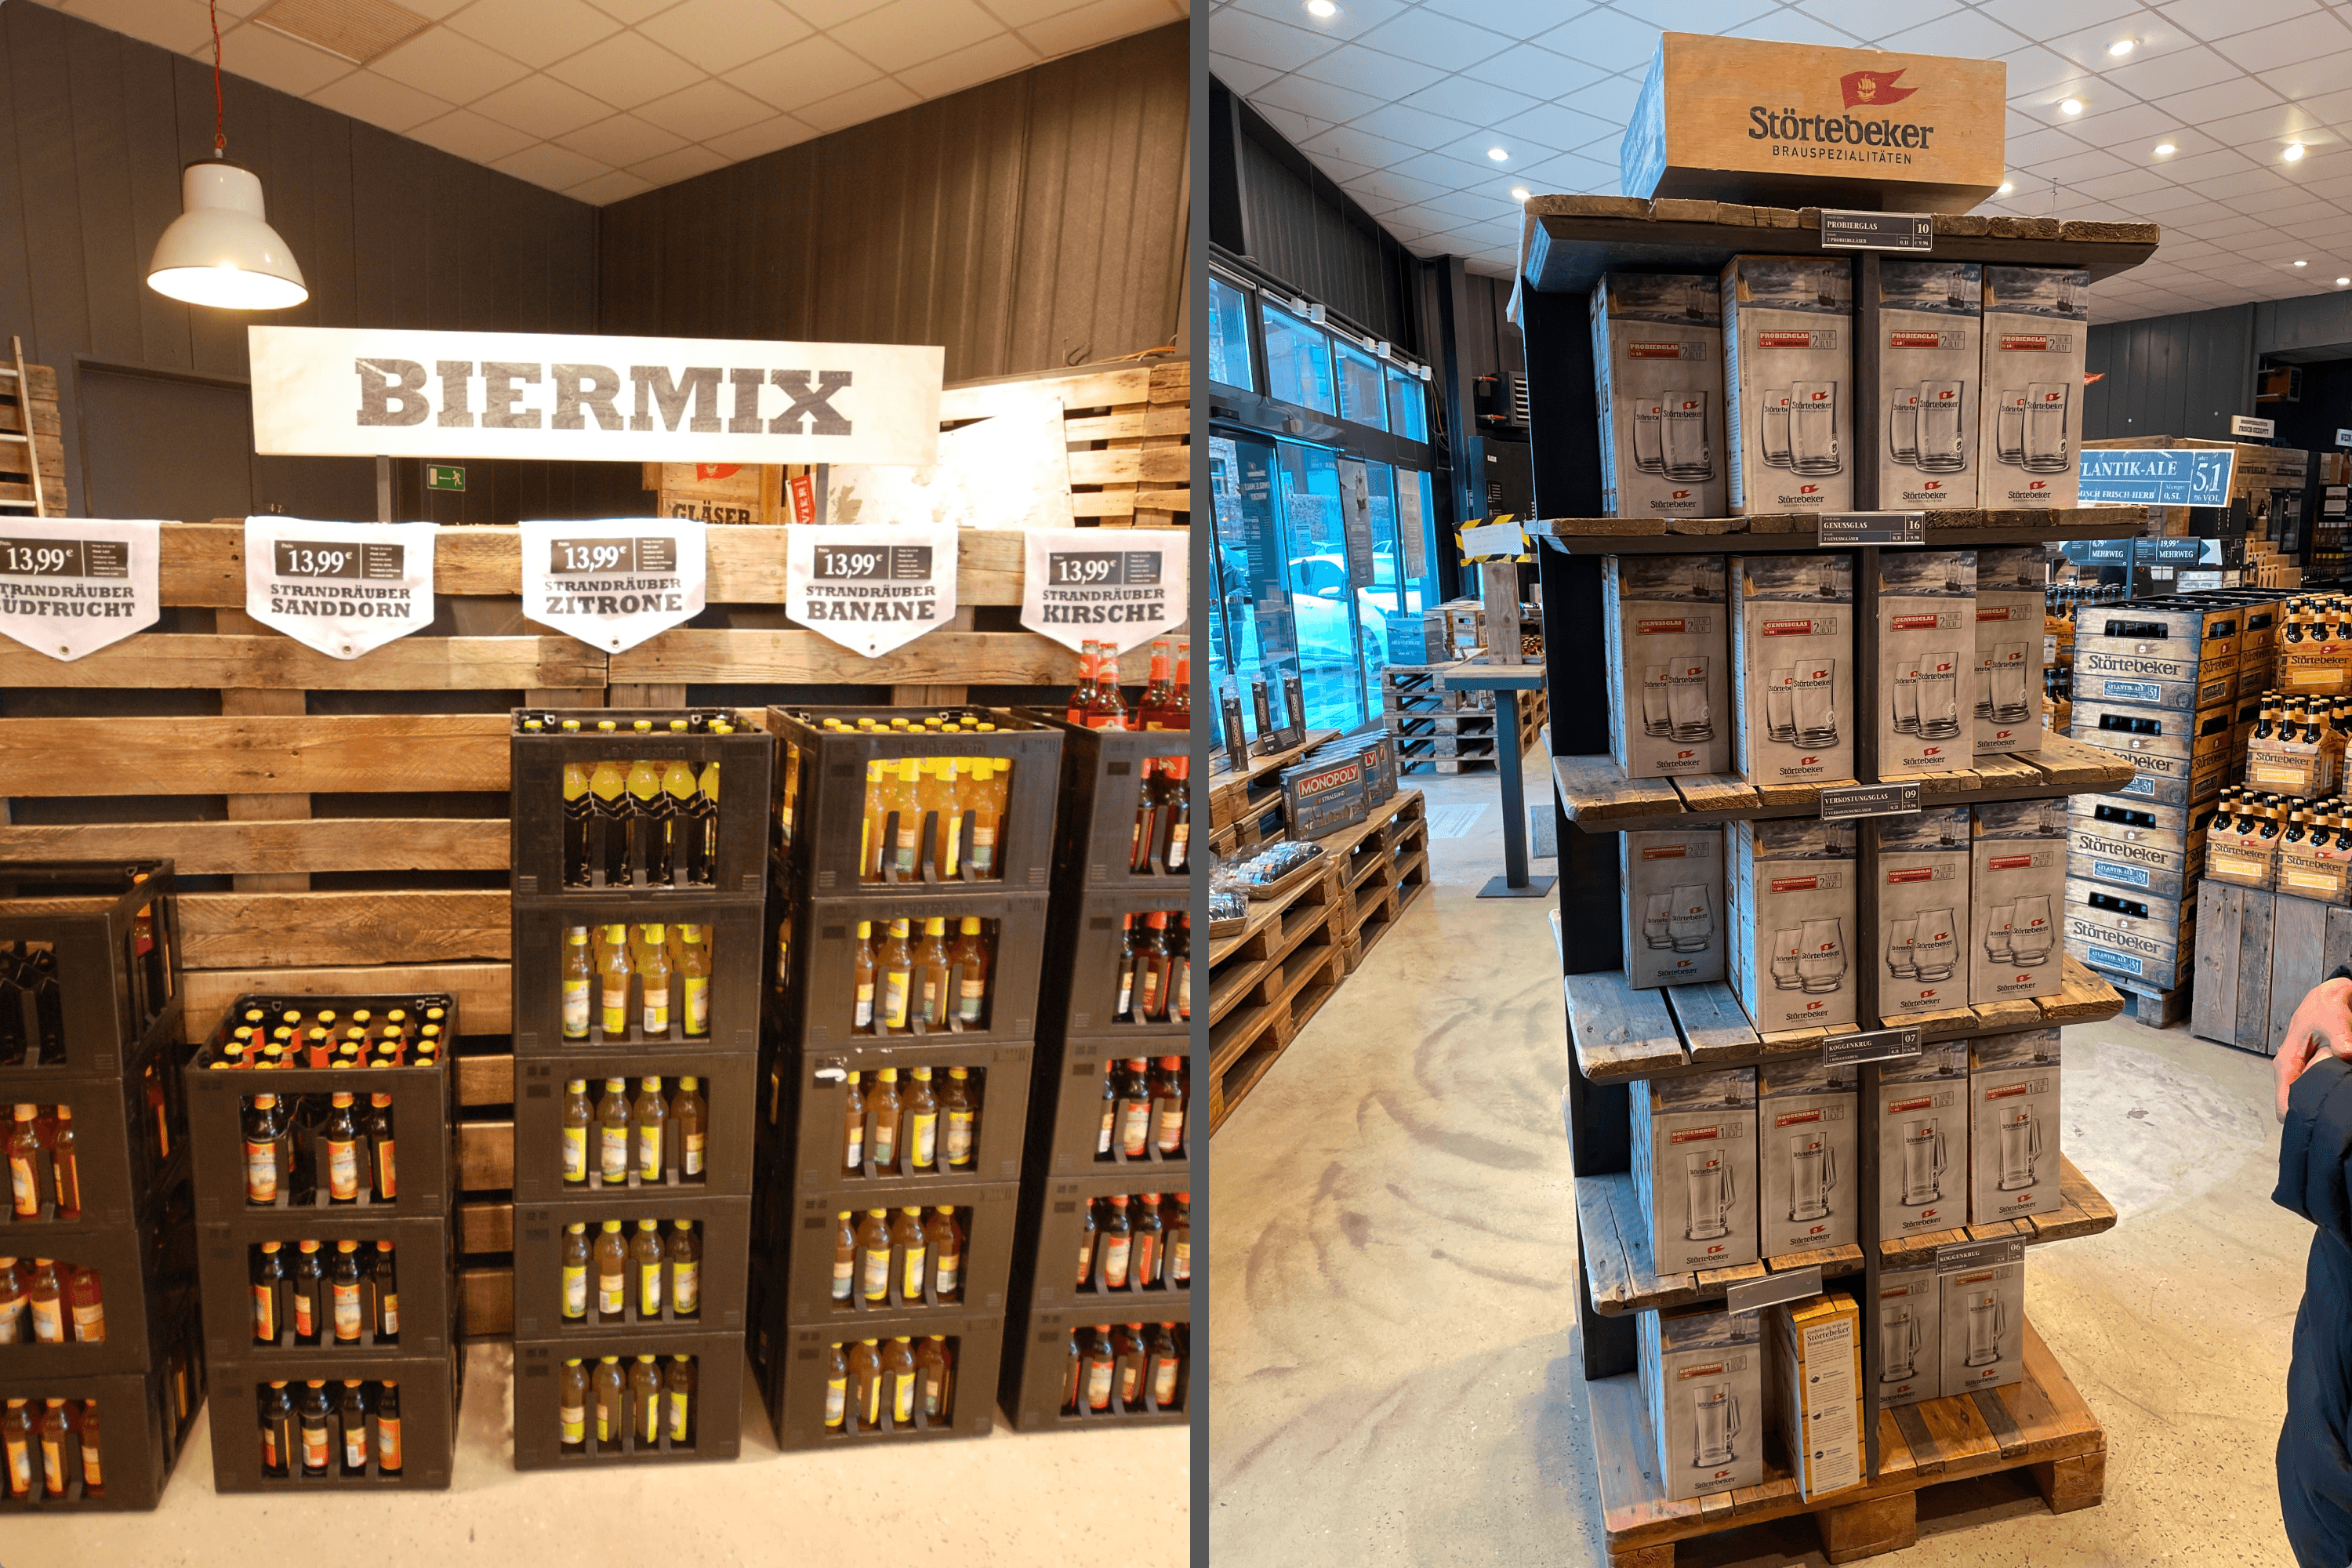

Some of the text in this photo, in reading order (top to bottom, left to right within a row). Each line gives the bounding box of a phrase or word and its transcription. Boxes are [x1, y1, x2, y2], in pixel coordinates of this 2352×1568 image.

[1749, 107, 1934, 149] Störtebeker
[1773, 145, 1911, 165] BRAUSPEZIALITÄTEN
[1827, 220, 1878, 230] PROBIERGLAS
[1917, 223, 1929, 234] 10
[1812, 334, 1819, 347] 2
[1941, 335, 1947, 347] 2
[2049, 338, 2055, 350] 2
[355, 357, 852, 436] BIERMIX
[1792, 401, 1831, 410] Störtebeker
[1919, 400, 1958, 409] Störtebeker
[2027, 401, 2063, 410] Störtebeker
[1663, 410, 1703, 419] Störtebeker
[2193, 463, 2221, 492] 5,1
[1778, 495, 1824, 504] Störtebeker
[1903, 492, 1947, 501] Störtebeker
[2008, 491, 2051, 499] Störtebeker
[1650, 499, 1697, 509] Störtebeker
[672, 500, 750, 524] GLÄSER
[1909, 521, 1920, 529] 16
[545, 577, 681, 592] STRANDRÄUBER
[270, 584, 411, 599] STRANDRÄUBER
[806, 584, 935, 597] STRANDRÄUBER
[1043, 587, 1165, 601] STRANDRÄUBER
[0, 593, 135, 618] ÜDFRUCHT
[271, 598, 411, 618] SANDDORN
[546, 593, 682, 615] ZITRONE
[806, 600, 935, 622] BANANE
[1043, 603, 1165, 623] KIRSCHE
[1940, 616, 1945, 627] 2
[1688, 622, 1693, 633] 2
[1813, 622, 1819, 634] 2
[2089, 655, 2181, 675] Störtebeker
[2292, 655, 2349, 665] Störtebeker
[2202, 658, 2235, 675] Störtebeker
[1668, 675, 1706, 684] Störtebeker
[1918, 672, 1955, 681] Störtebeker
[1793, 679, 1831, 688] Störtebeker
[1232, 717, 1241, 746] MONOPOLY
[1977, 739, 2016, 748] Störtebeker
[1657, 759, 1700, 768] Störtebeker
[1903, 757, 1945, 766] Störtebeker
[2196, 751, 2227, 770] Störtebeker
[2256, 753, 2310, 766] Störtebeker
[1780, 766, 1824, 775] Störtebeker
[1301, 766, 1357, 796] MONOPOLY
[1322, 790, 1345, 803] STRALSUND
[1824, 793, 1889, 804] VERKOSTUNGSGLAS
[1905, 789, 1916, 799] 09
[2079, 836, 2169, 864] Störtebeker
[2214, 844, 2267, 860] Störtebeker
[2287, 855, 2343, 872] Störtebeker
[1820, 877, 1825, 888] 2
[1671, 913, 1708, 922] Störtebeker
[2013, 925, 2049, 935] Störtebeker
[2074, 921, 2160, 954] Störtebeker
[1916, 939, 1952, 949] Störtebeker
[1802, 949, 1839, 960] Störtebeker
[1657, 967, 1697, 977] Störtebeker
[1997, 982, 2035, 992] Störtebeker
[1900, 998, 1940, 1008] Störtebeker
[1786, 1010, 1828, 1020] Störtebeker
[1905, 1034, 1916, 1043] 07
[1829, 1040, 1872, 1051] KOGGENKRUG
[1987, 1083, 2026, 1094] KOGGENKRUG
[1890, 1097, 1930, 1107] KOGGENKRUG
[1777, 1110, 1819, 1120] KOGGENKRUG
[1672, 1127, 1716, 1136] KOGGENKRUG
[1999, 1201, 2036, 1213] Störtebeker
[1902, 1217, 1941, 1229] Störtebeker
[1790, 1233, 1831, 1245] Störtebeker
[1686, 1253, 1730, 1265] Störtebeker
[1940, 1250, 1980, 1262] KOGGENKRUG
[1807, 1327, 1849, 1341] Störtebeker
[1679, 1362, 1722, 1374] KOGGENKRUG
[1695, 1476, 1736, 1489] Störtebeker
